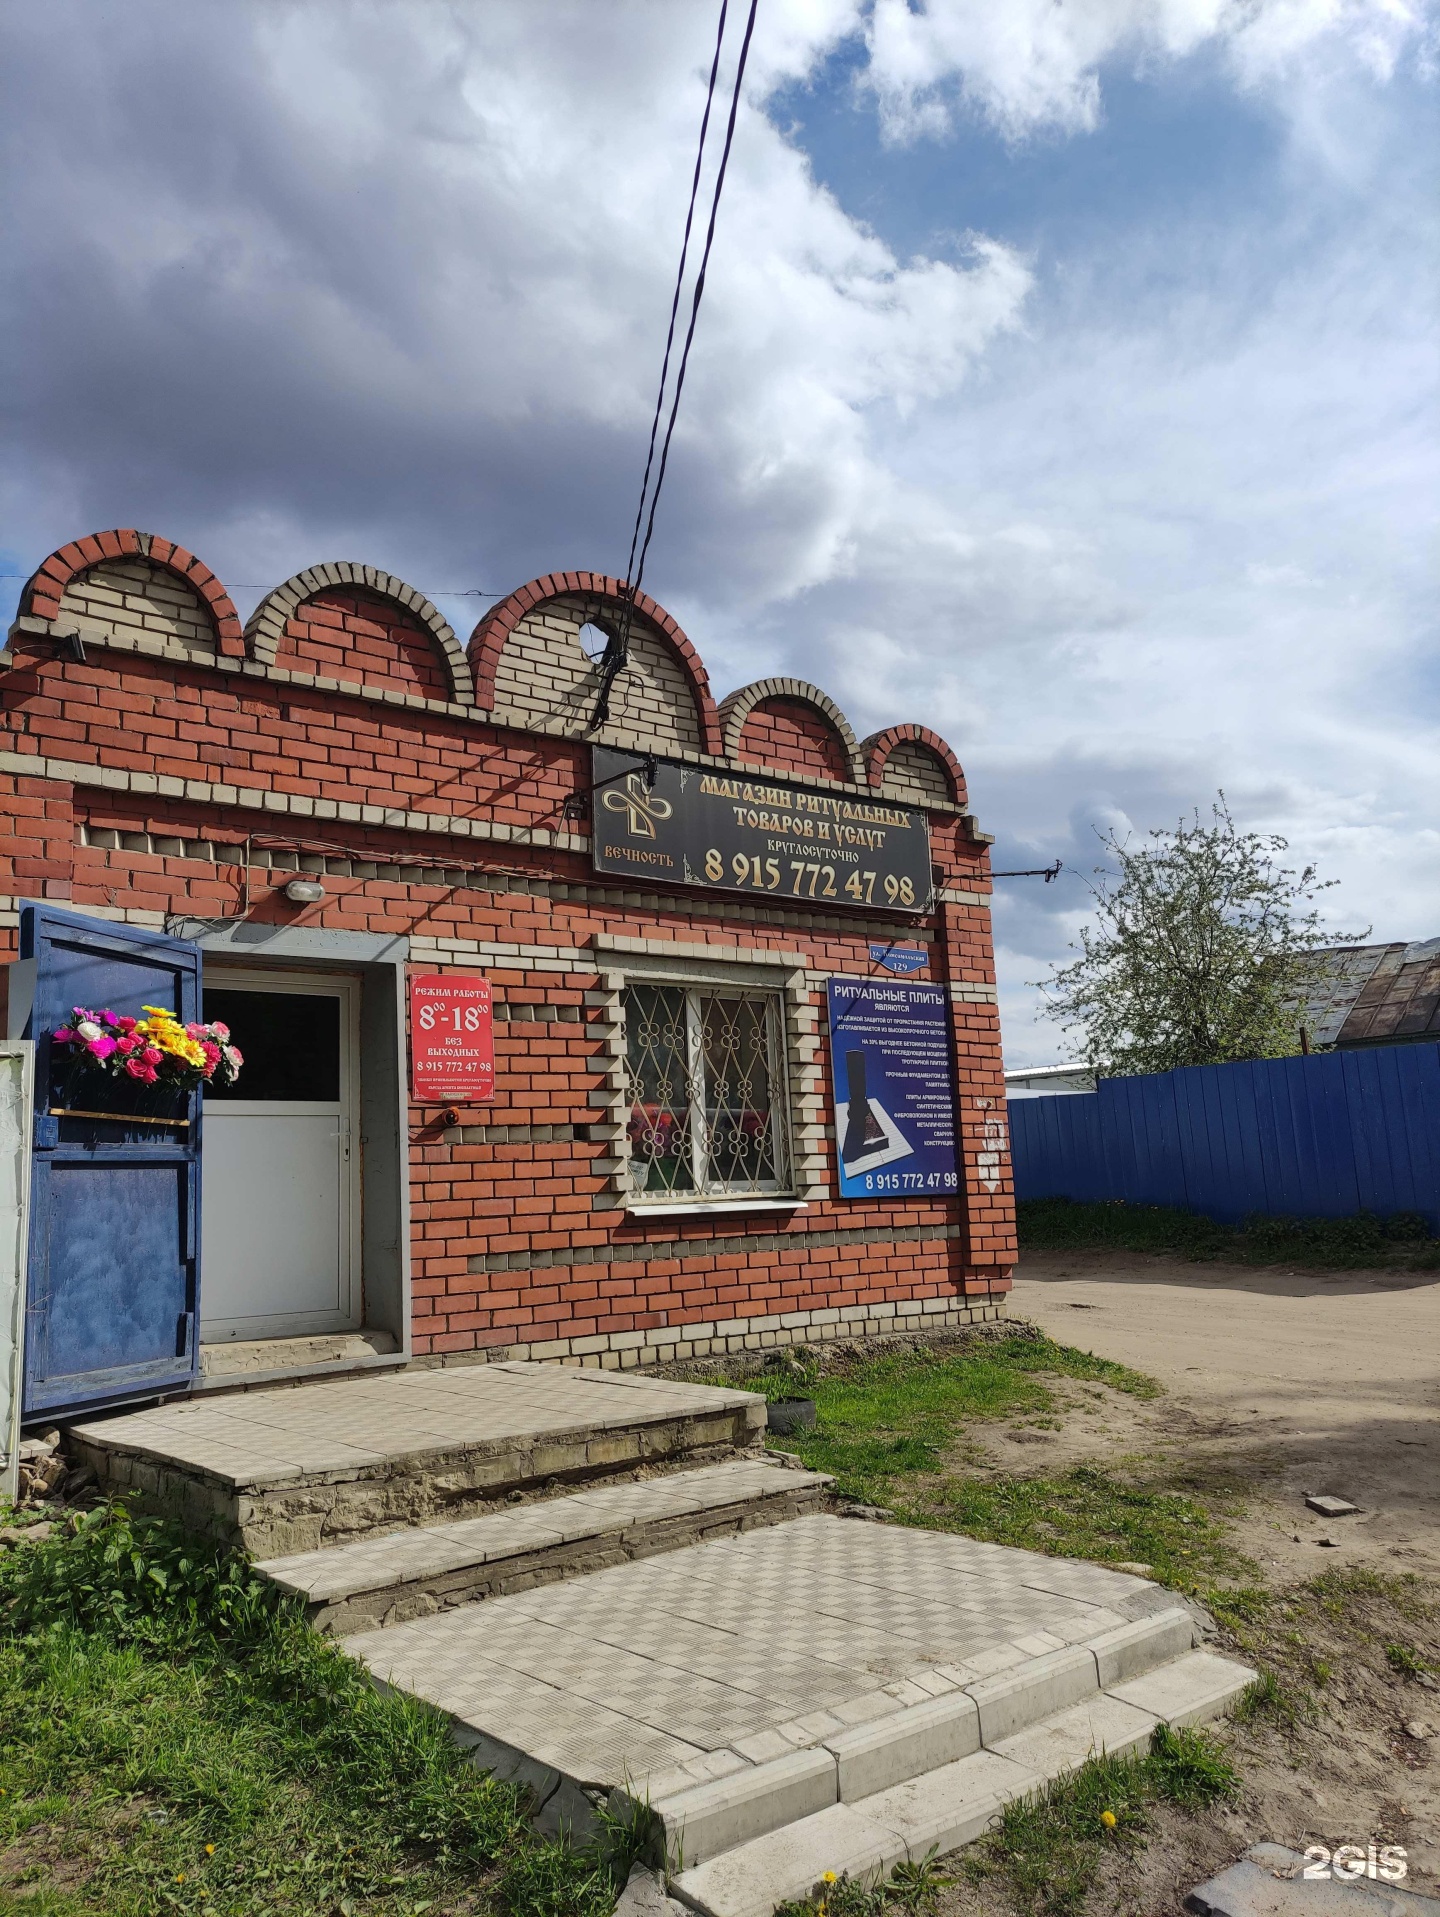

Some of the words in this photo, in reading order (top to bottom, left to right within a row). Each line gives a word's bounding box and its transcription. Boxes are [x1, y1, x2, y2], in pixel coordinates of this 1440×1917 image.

[700, 775, 792, 809] МАГАЗИН
[796, 794, 911, 828] РИТУАЛЬНЫХ
[733, 806, 813, 838] ТОВАРОВ
[817, 821, 831, 840] И
[834, 825, 886, 851] УСЛУГ
[604, 845, 674, 867] ВЕЧНОСТЬ
[767, 839, 859, 863] КРУГЛОСУТОЧНО
[705, 848, 724, 882] 8
[732, 852, 781, 889] 915
[790, 861, 838, 897] 772
[845, 869, 877, 904] 47
[884, 874, 915, 905] 98
[415, 988, 451, 996] РЕЖИМ
[454, 989, 488, 998] РАБОТЫ
[834, 986, 907, 1002] РИТУАЛЬНЫЕ
[909, 992, 944, 1005] ПЛИТЫ
[875, 1003, 909, 1012] ЯВЛЯЮТСЯ
[445, 1037, 462, 1046] БЕЗ
[428, 1048, 479, 1057] ВЫХОДНЫХ
[417, 1061, 423, 1071] 8
[426, 1062, 442, 1071] 915
[446, 1062, 462, 1072] 772
[465, 1062, 477, 1072] 47
[480, 1062, 491, 1072] 98
[866, 1175, 873, 1189] 8
[877, 1174, 899, 1189] 915
[902, 1174, 924, 1188] 772
[927, 1173, 940, 1187] 47
[944, 1173, 957, 1187] 98
